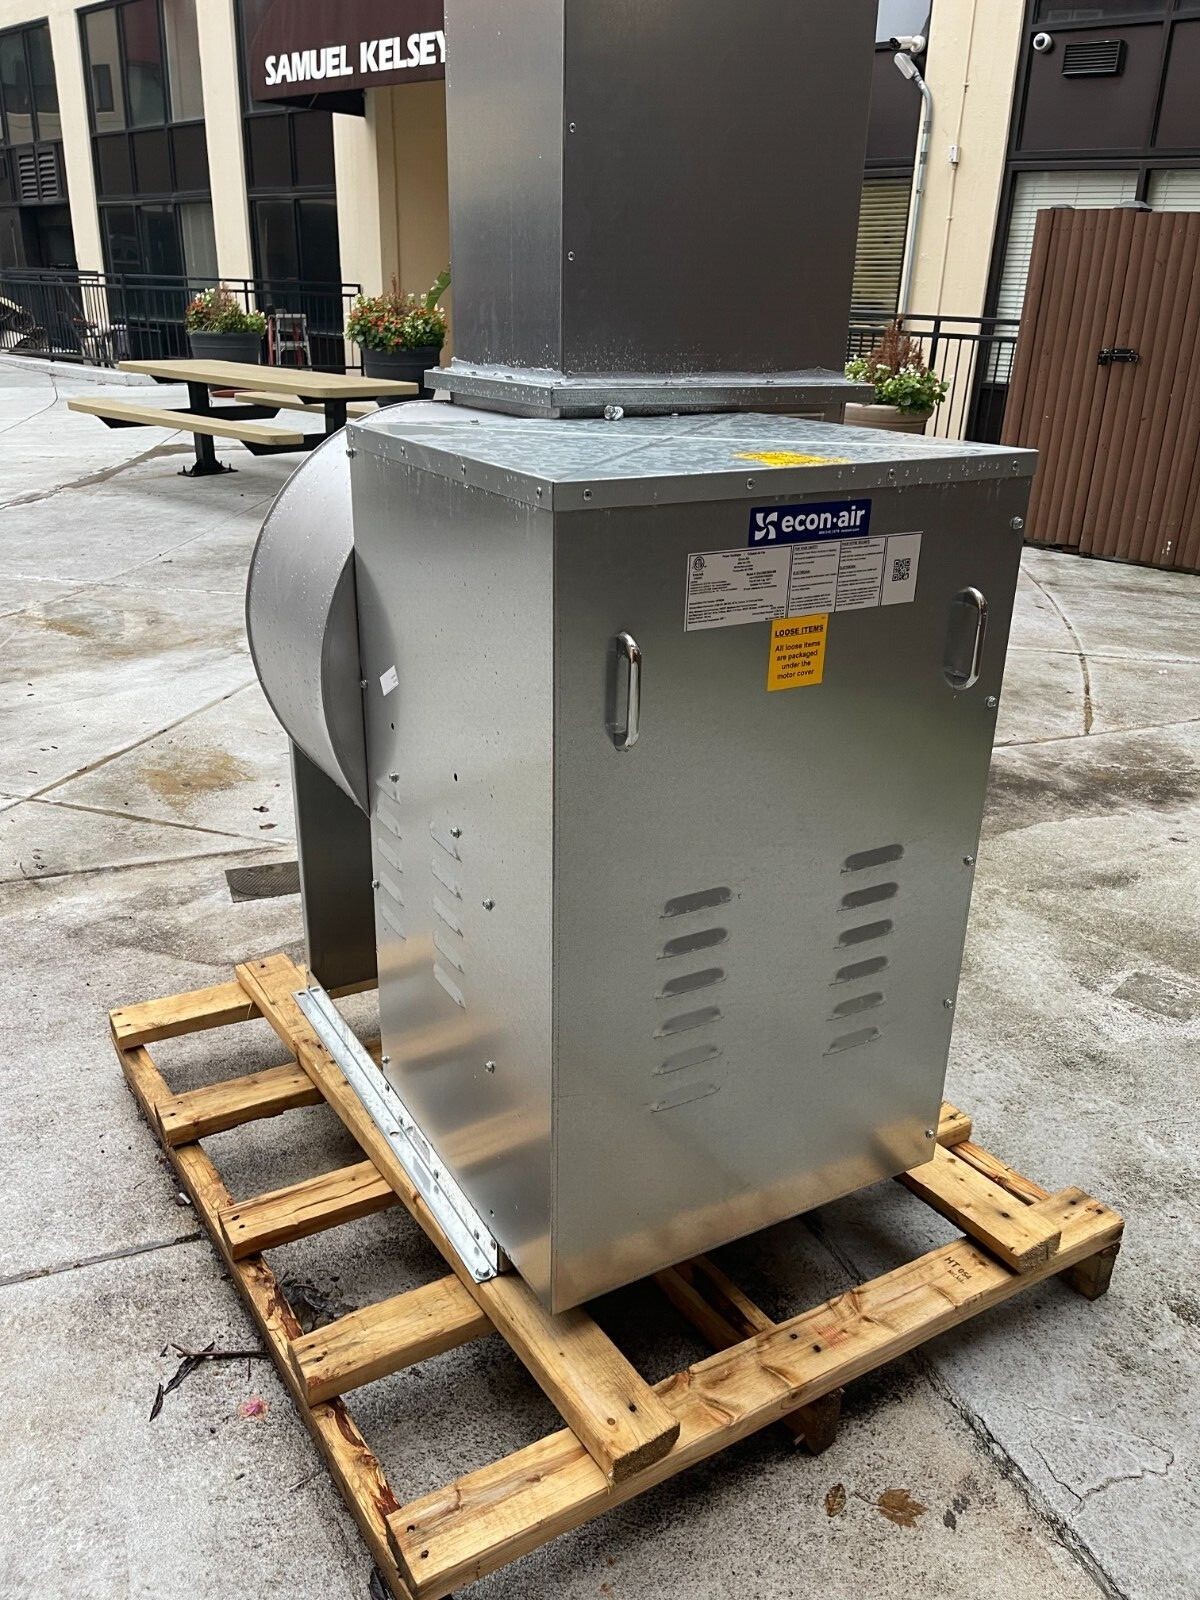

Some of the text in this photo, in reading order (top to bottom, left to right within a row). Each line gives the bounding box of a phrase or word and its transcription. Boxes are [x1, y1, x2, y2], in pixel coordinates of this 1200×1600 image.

[264, 30, 447, 86] SAMUEL KELSEY
[775, 624, 824, 638] LOOSE ITEMS
[775, 640, 821, 652] All loose items
[787, 649, 818, 662] packaged
[781, 661, 800, 670] under
[776, 669, 815, 680] motor cover
[944, 1256, 961, 1268] HT
